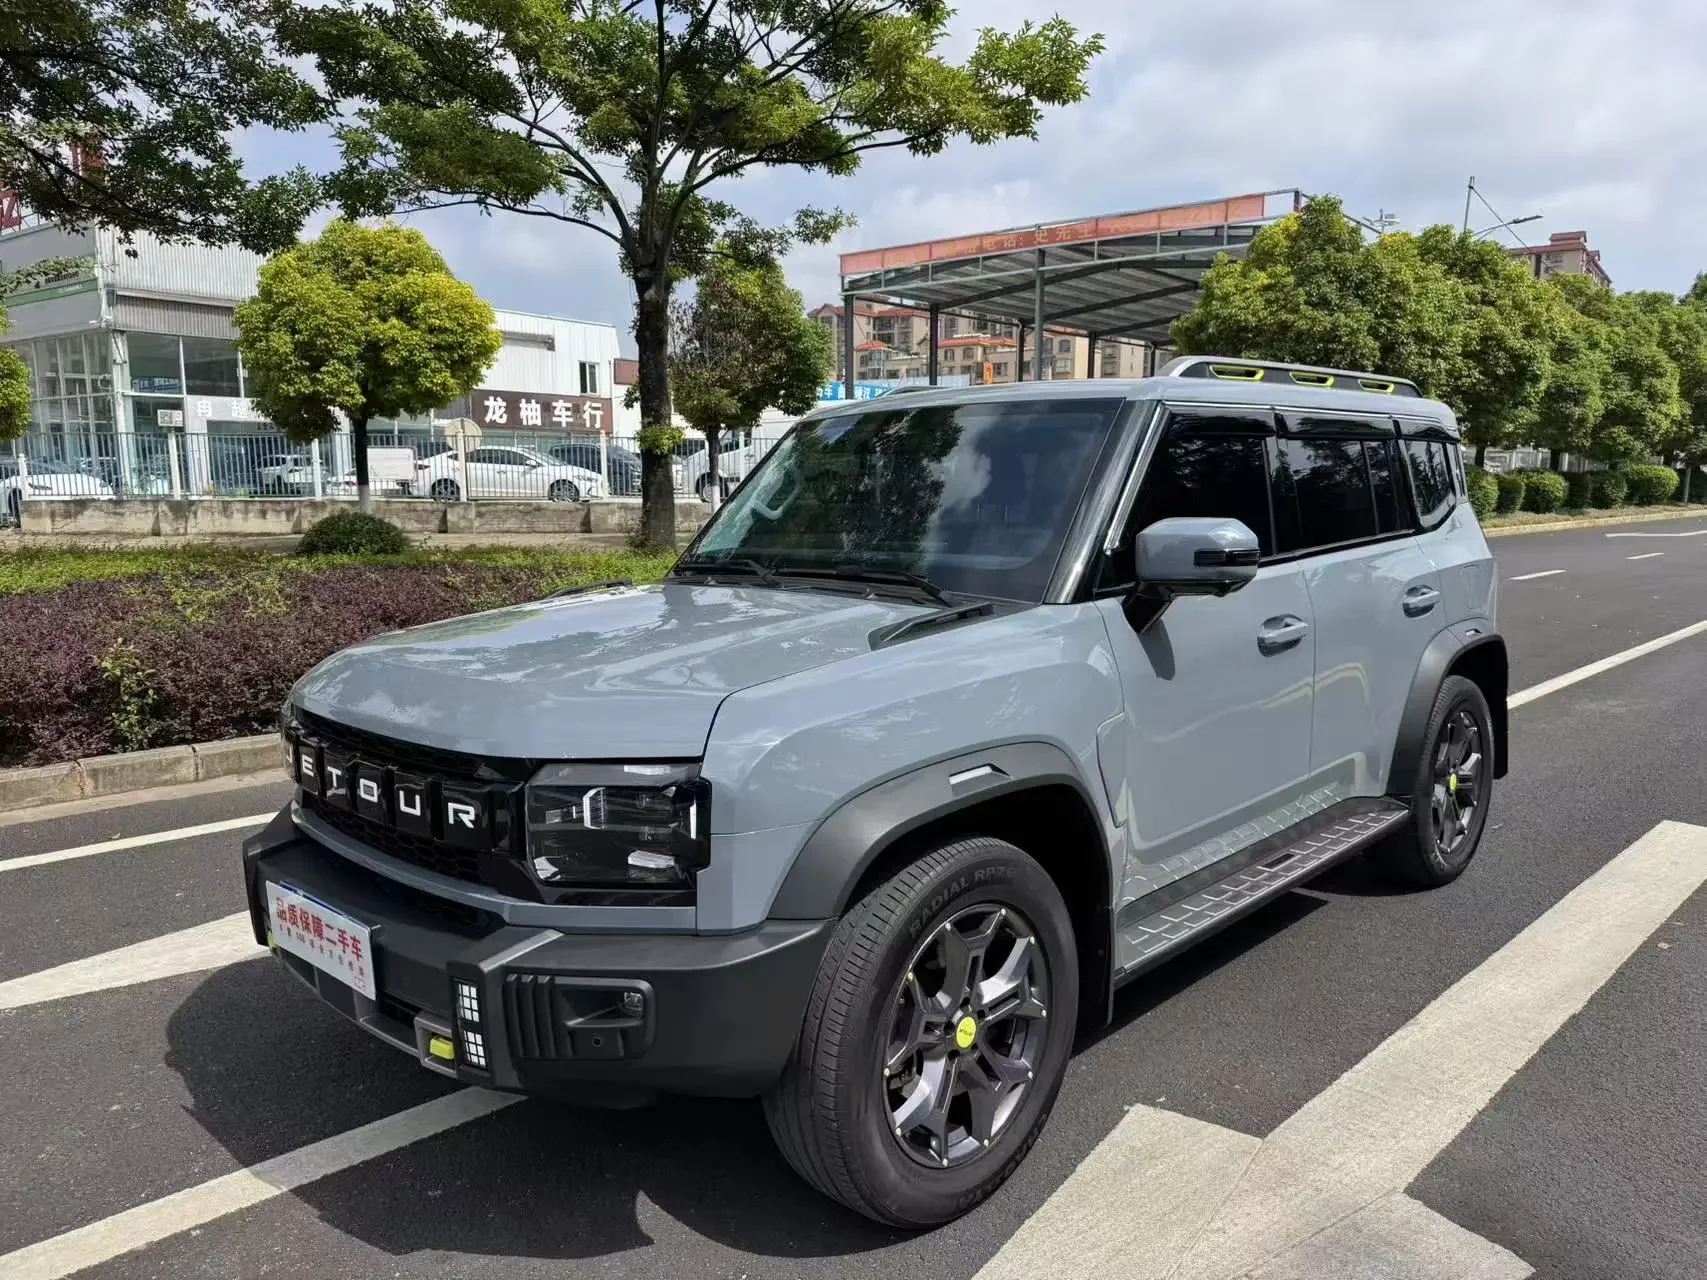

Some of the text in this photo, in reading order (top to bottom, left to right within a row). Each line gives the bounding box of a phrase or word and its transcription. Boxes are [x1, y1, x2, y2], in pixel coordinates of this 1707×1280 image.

[484, 396, 604, 429] 龙柚车行
[276, 896, 363, 961] 品质保障二手车
